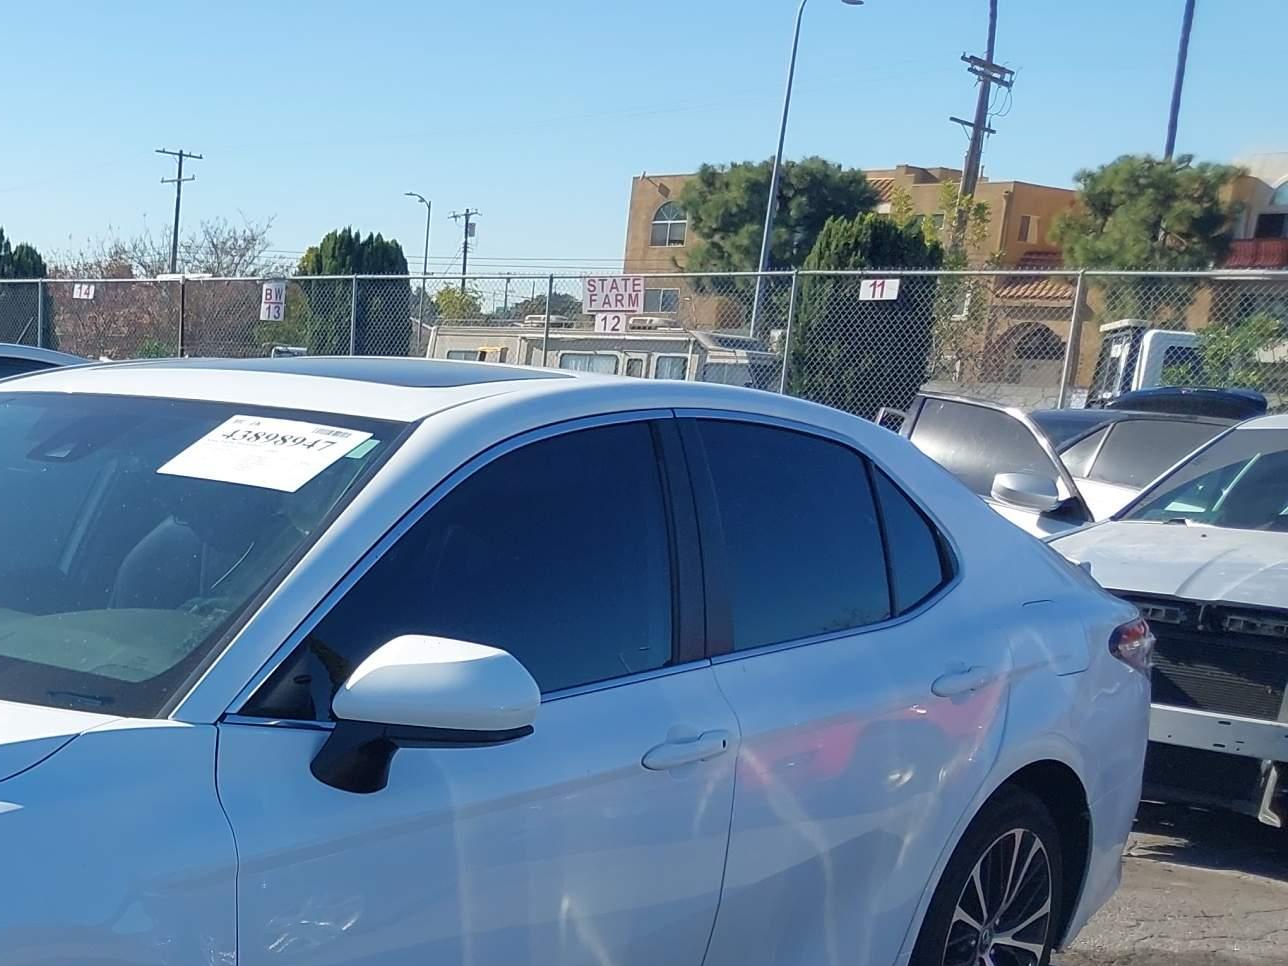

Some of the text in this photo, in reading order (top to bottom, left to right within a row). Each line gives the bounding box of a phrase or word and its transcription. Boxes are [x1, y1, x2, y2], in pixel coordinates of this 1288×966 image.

[77, 284, 91, 298] 14
[587, 278, 642, 293] STATE
[869, 280, 886, 299] 11
[265, 287, 284, 301] BW
[589, 293, 639, 308] FARM
[265, 304, 281, 320] 13
[600, 315, 621, 332] 12
[222, 428, 337, 451] 43898947
